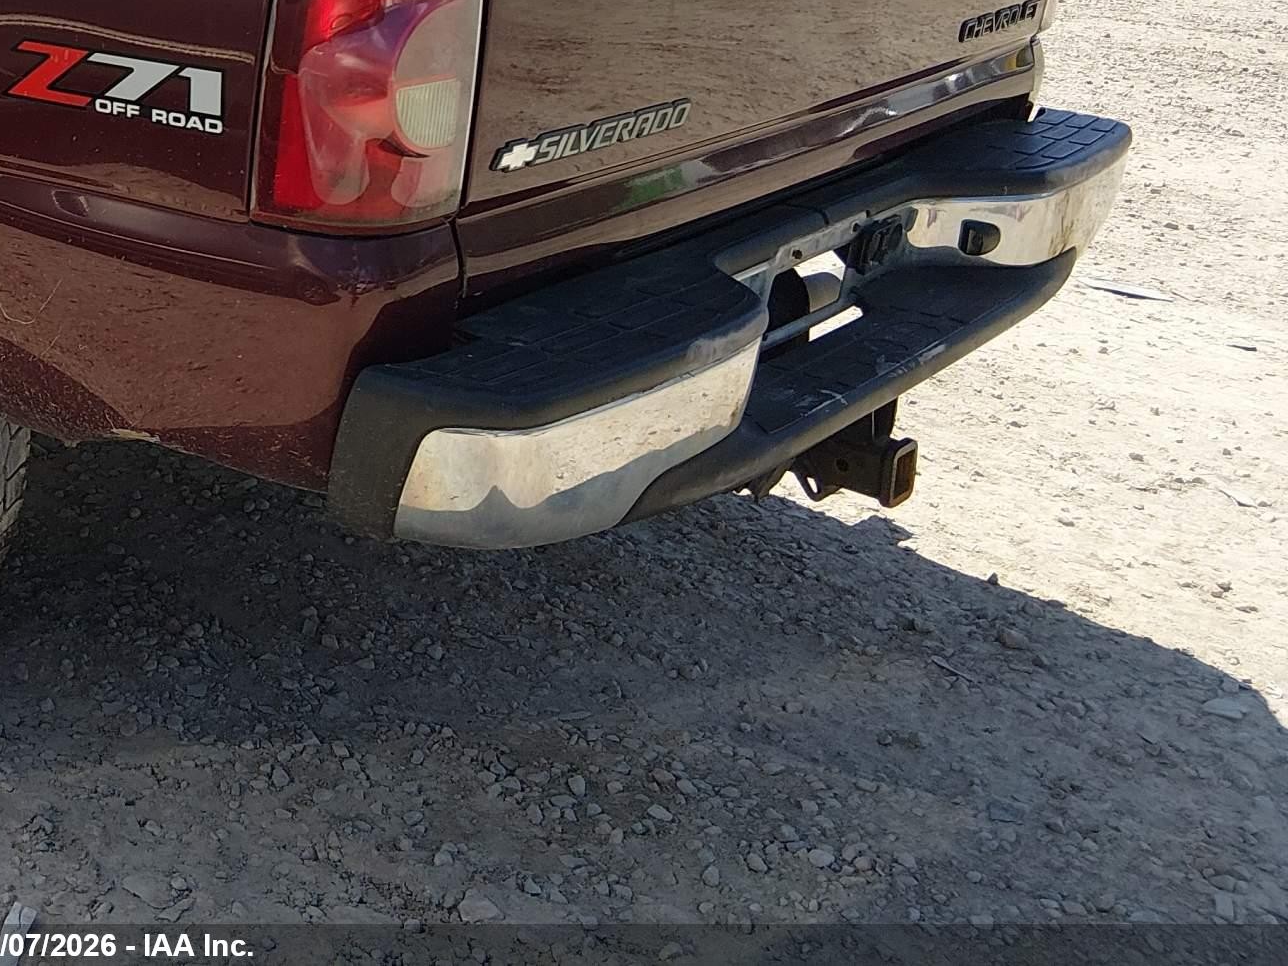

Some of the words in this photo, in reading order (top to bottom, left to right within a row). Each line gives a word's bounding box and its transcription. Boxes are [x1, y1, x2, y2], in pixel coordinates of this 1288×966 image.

[7, 40, 223, 118] Z71
[95, 89, 140, 118] OFF
[151, 109, 224, 134] ROAD
[532, 101, 692, 166] SILVERADO
